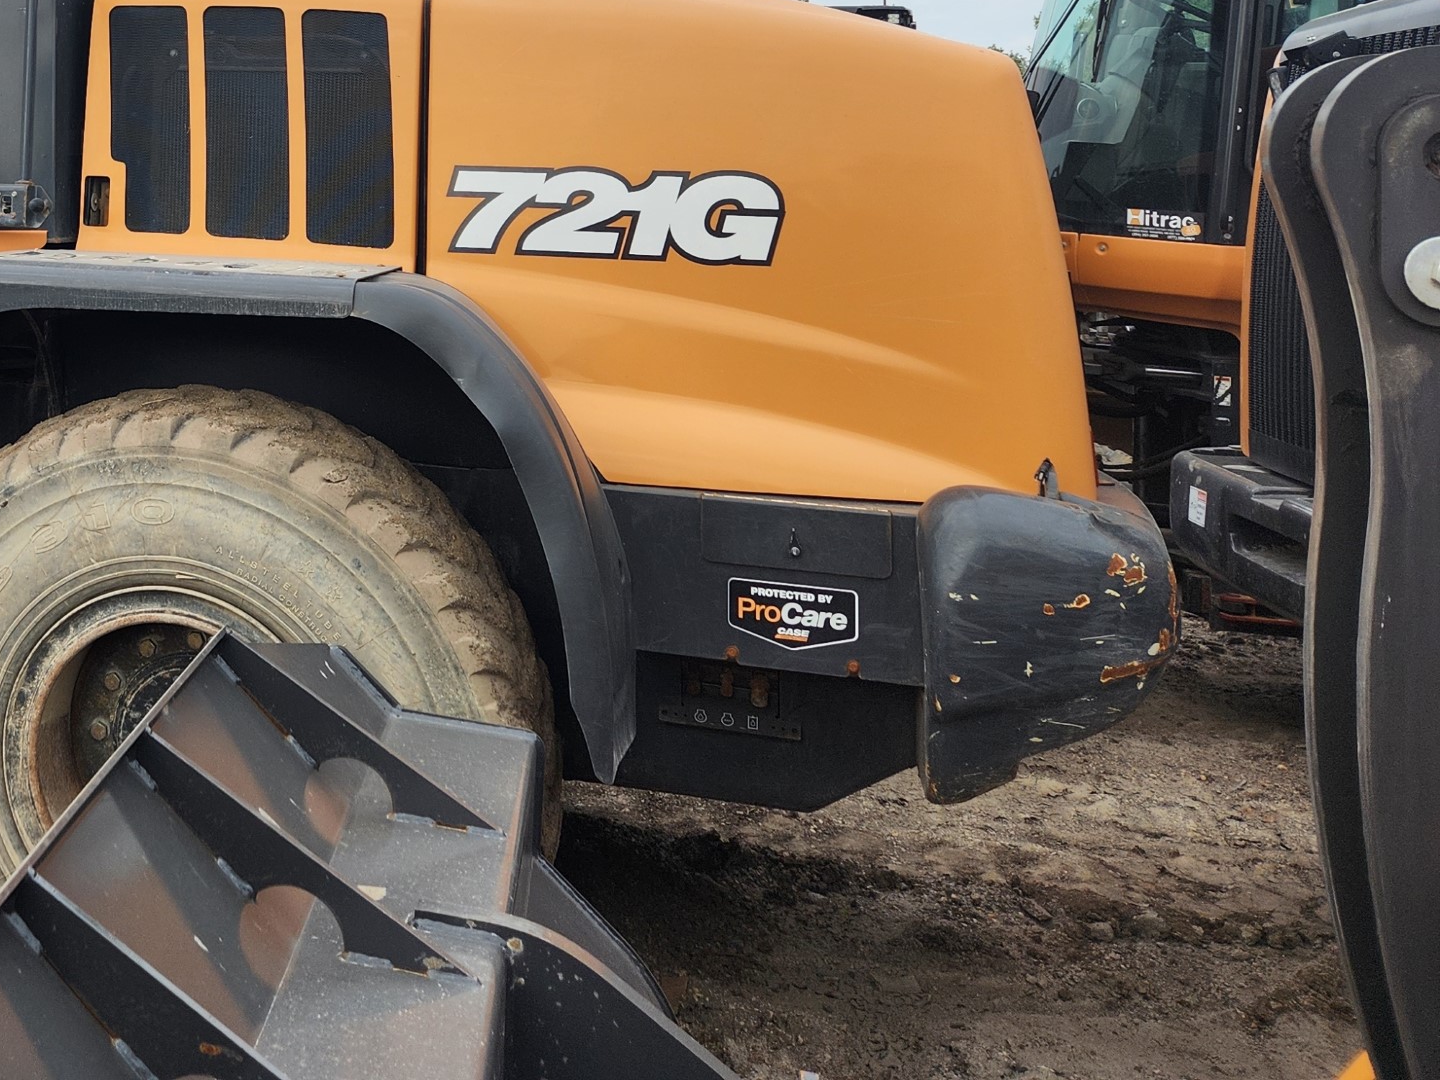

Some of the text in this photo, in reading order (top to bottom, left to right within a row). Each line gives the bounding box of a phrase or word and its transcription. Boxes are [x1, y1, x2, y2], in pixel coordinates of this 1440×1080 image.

[447, 166, 786, 266] 721G
[1126, 208, 1195, 229] Hitrac
[750, 586, 834, 604] PROTECTED BY
[737, 596, 848, 631] ProCare
[776, 627, 810, 637] CASE
